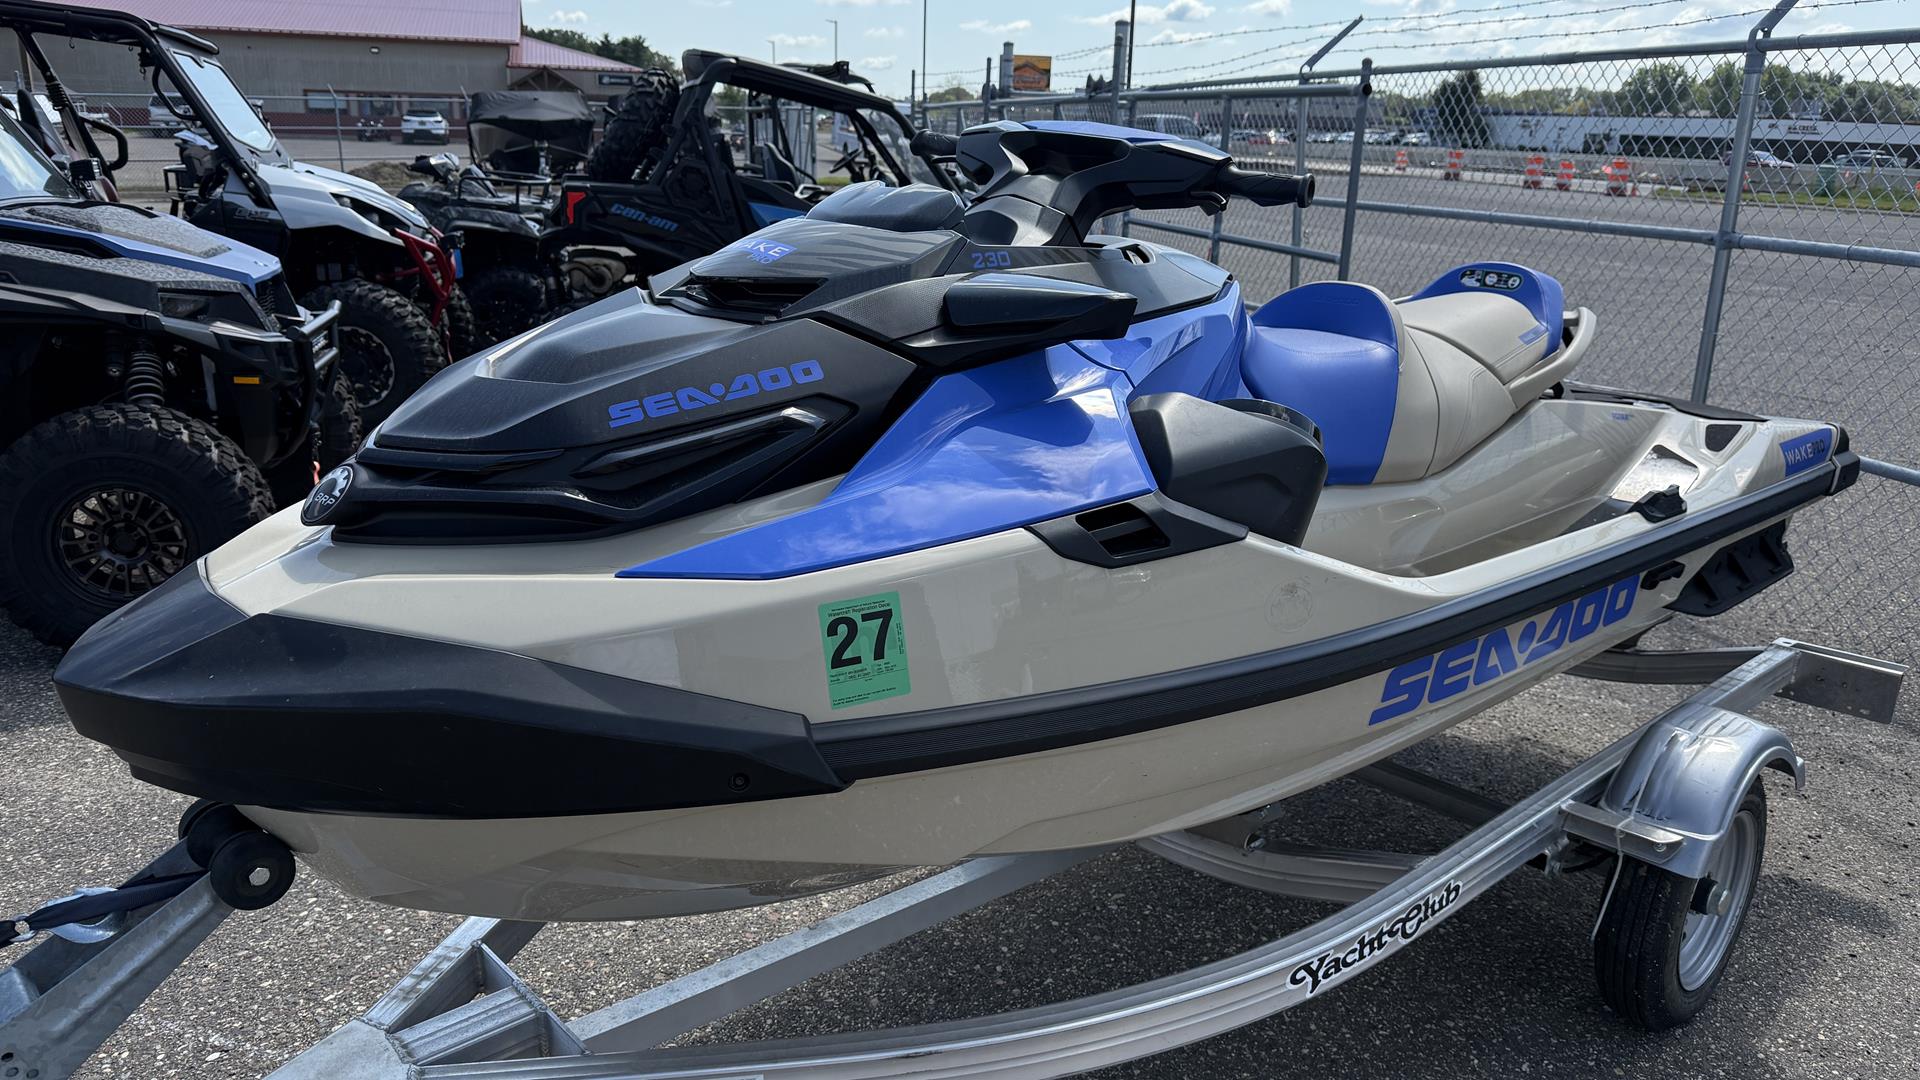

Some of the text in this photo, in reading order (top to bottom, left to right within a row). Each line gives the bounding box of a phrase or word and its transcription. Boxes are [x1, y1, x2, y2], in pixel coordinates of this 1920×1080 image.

[971, 251, 1011, 268] 230
[315, 492, 336, 506] BRP
[826, 608, 893, 670] 27
